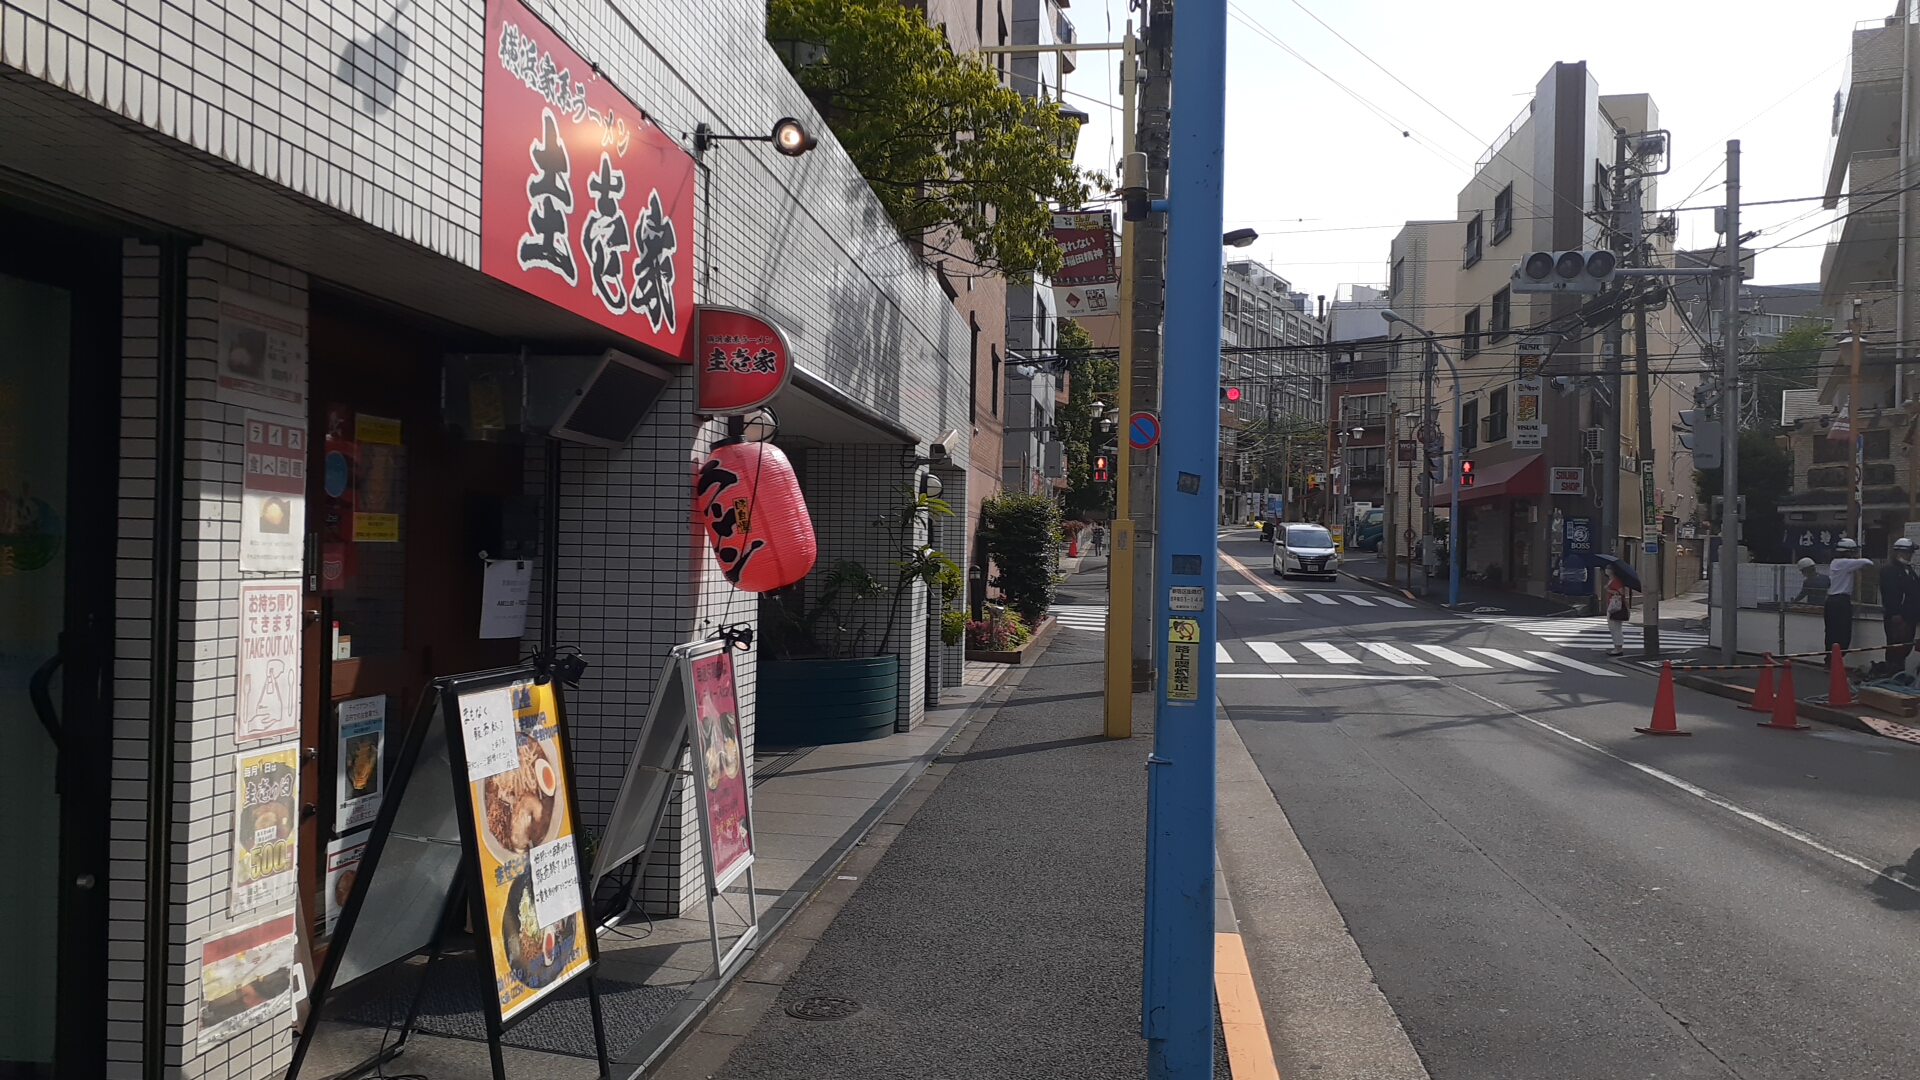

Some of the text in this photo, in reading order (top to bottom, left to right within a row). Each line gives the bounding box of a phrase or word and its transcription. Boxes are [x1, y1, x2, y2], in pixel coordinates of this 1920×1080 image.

[498, 20, 630, 157] 横浜家系ラーメン
[252, 425, 301, 446] ライス
[249, 455, 303, 477] 食べ放題
[1561, 482, 1580, 491] SHOP
[248, 593, 294, 613] お持ち帰り
[248, 614, 293, 634] できます
[244, 635, 295, 660] TAKE OUT OK
